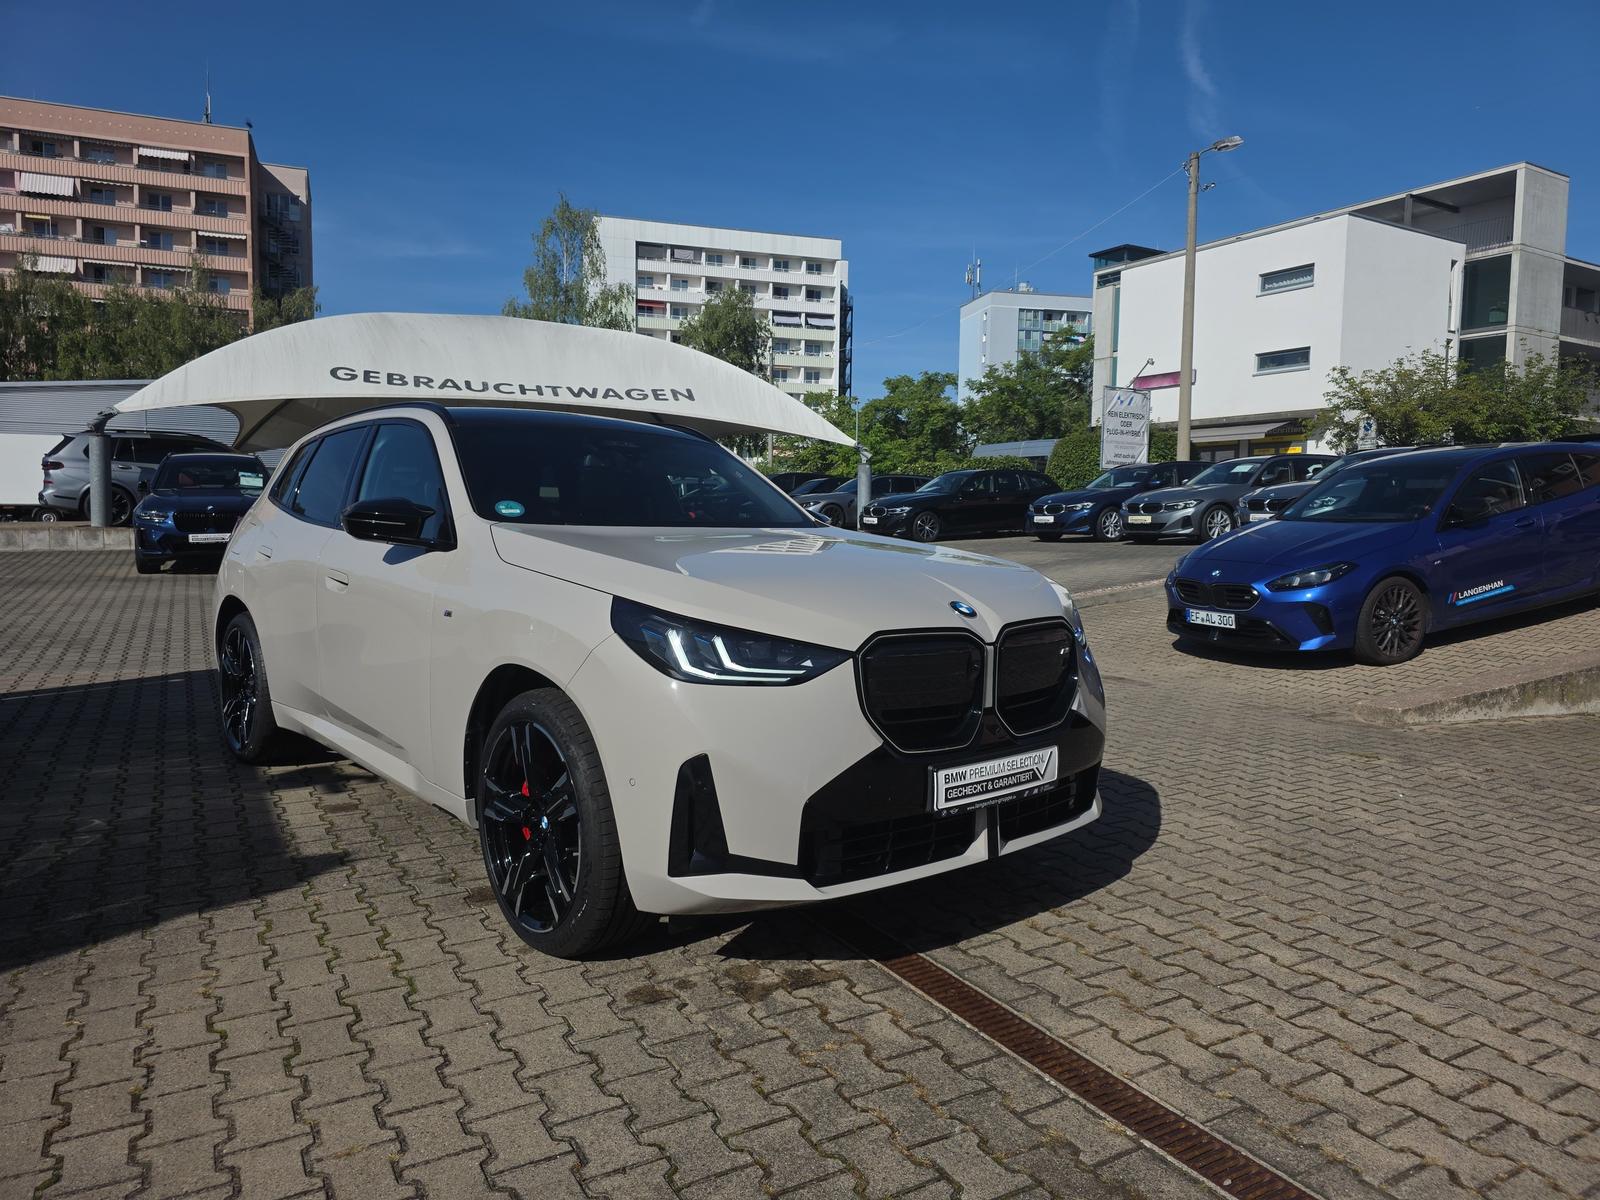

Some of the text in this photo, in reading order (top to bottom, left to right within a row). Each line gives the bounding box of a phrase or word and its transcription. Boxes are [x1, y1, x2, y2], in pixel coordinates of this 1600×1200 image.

[329, 366, 696, 402] GEBRAUCHTWAGEN
[1107, 410, 1145, 420] REIN ELEKTRISCH
[1120, 420, 1132, 428] ODER
[1458, 579, 1504, 599] LANGENHAN
[1190, 611, 1234, 626] EF AL 300
[944, 770, 968, 784] BMW
[969, 763, 1006, 779] PREMIUM
[947, 785, 987, 799] GECHECKT
[987, 781, 993, 791] &
[993, 771, 1034, 788] GARANTIERT
